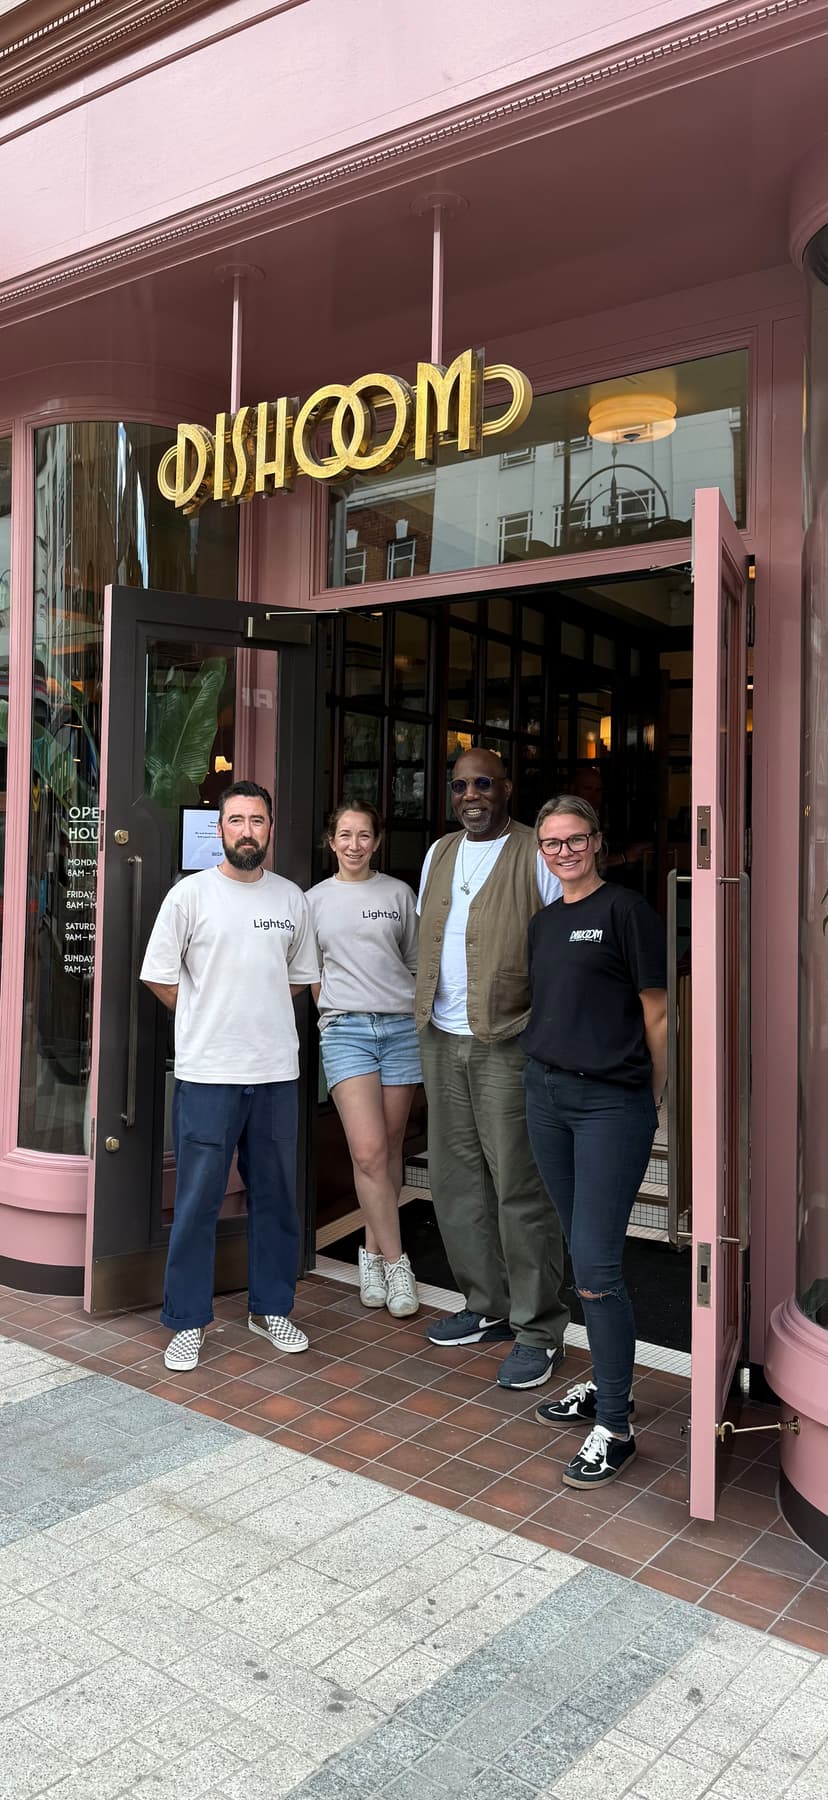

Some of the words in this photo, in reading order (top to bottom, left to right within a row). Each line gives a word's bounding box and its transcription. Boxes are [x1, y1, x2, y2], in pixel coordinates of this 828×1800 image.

[174, 348, 478, 508] DISHOOM
[65, 922, 96, 930] SATURD
[253, 918, 295, 932] LightsOn
